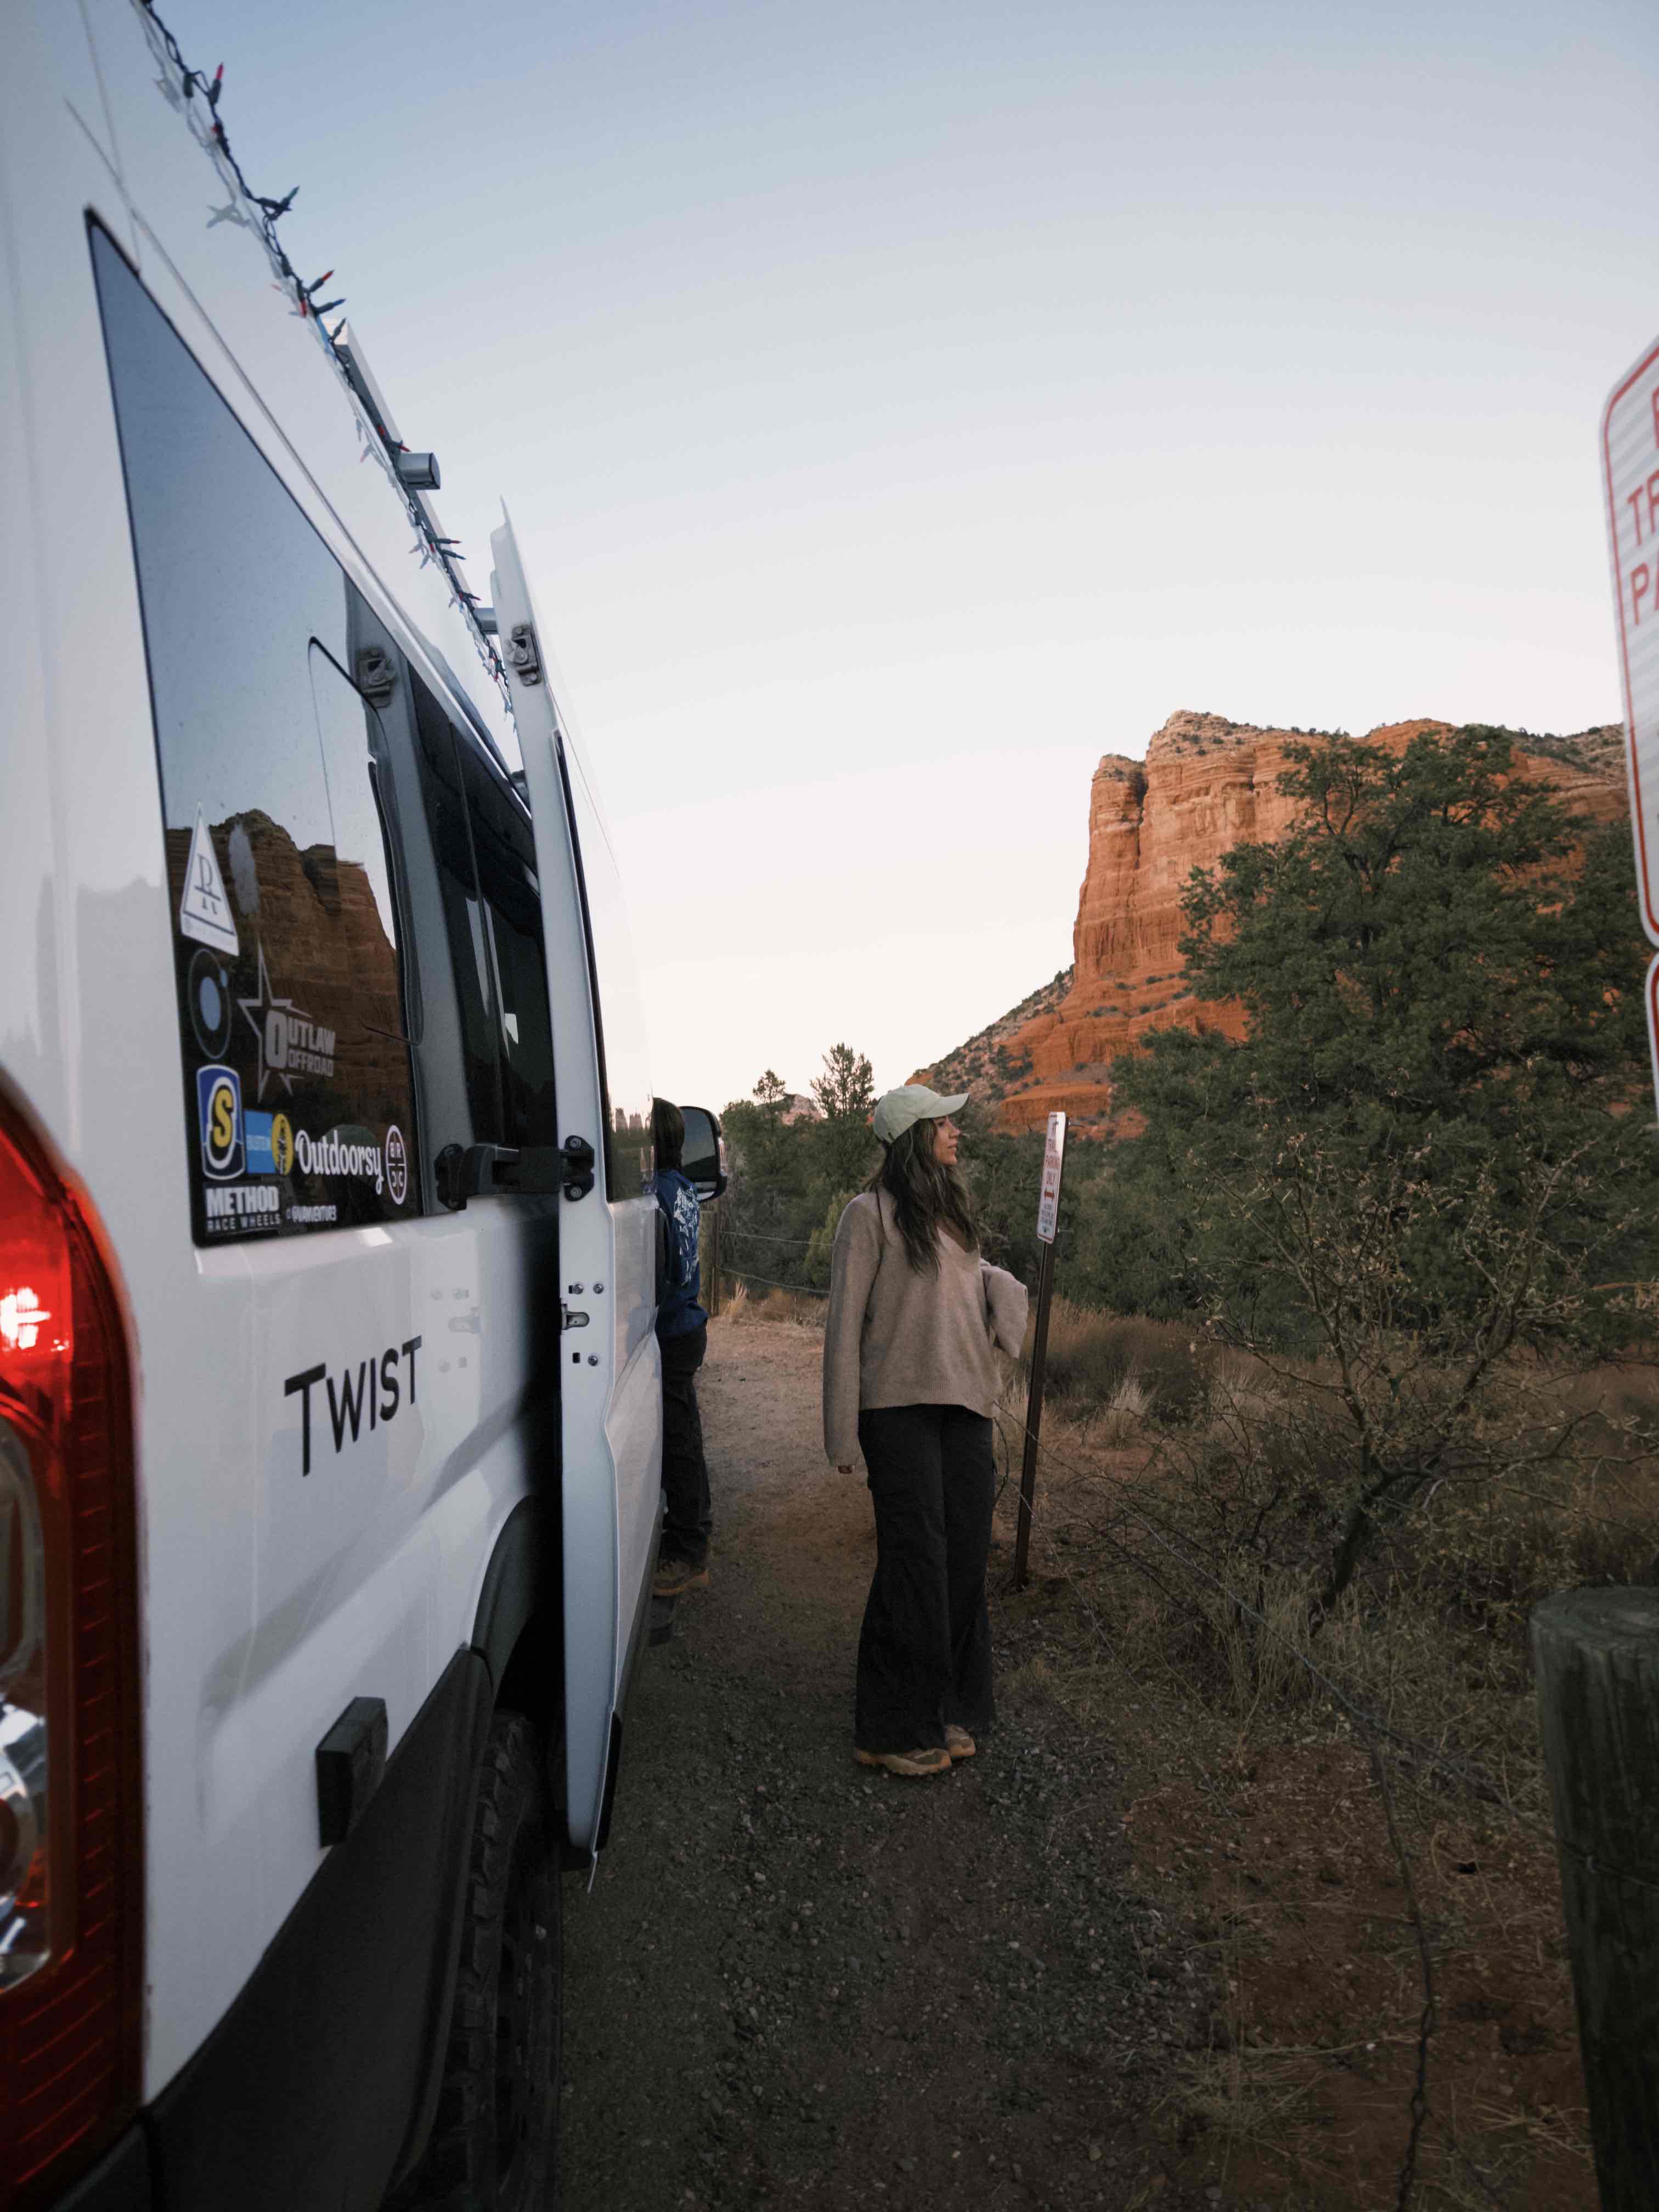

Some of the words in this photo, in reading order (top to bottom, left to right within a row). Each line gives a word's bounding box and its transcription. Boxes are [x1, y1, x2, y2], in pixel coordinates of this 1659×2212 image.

[288, 1049, 334, 1077] OFFROAD
[295, 1130, 384, 1195] Outdoorsy
[206, 1186, 279, 1217] METHOD
[207, 1218, 236, 1232] RACE
[240, 1214, 281, 1229] WHEELS
[285, 1335, 421, 1477] TWIST
